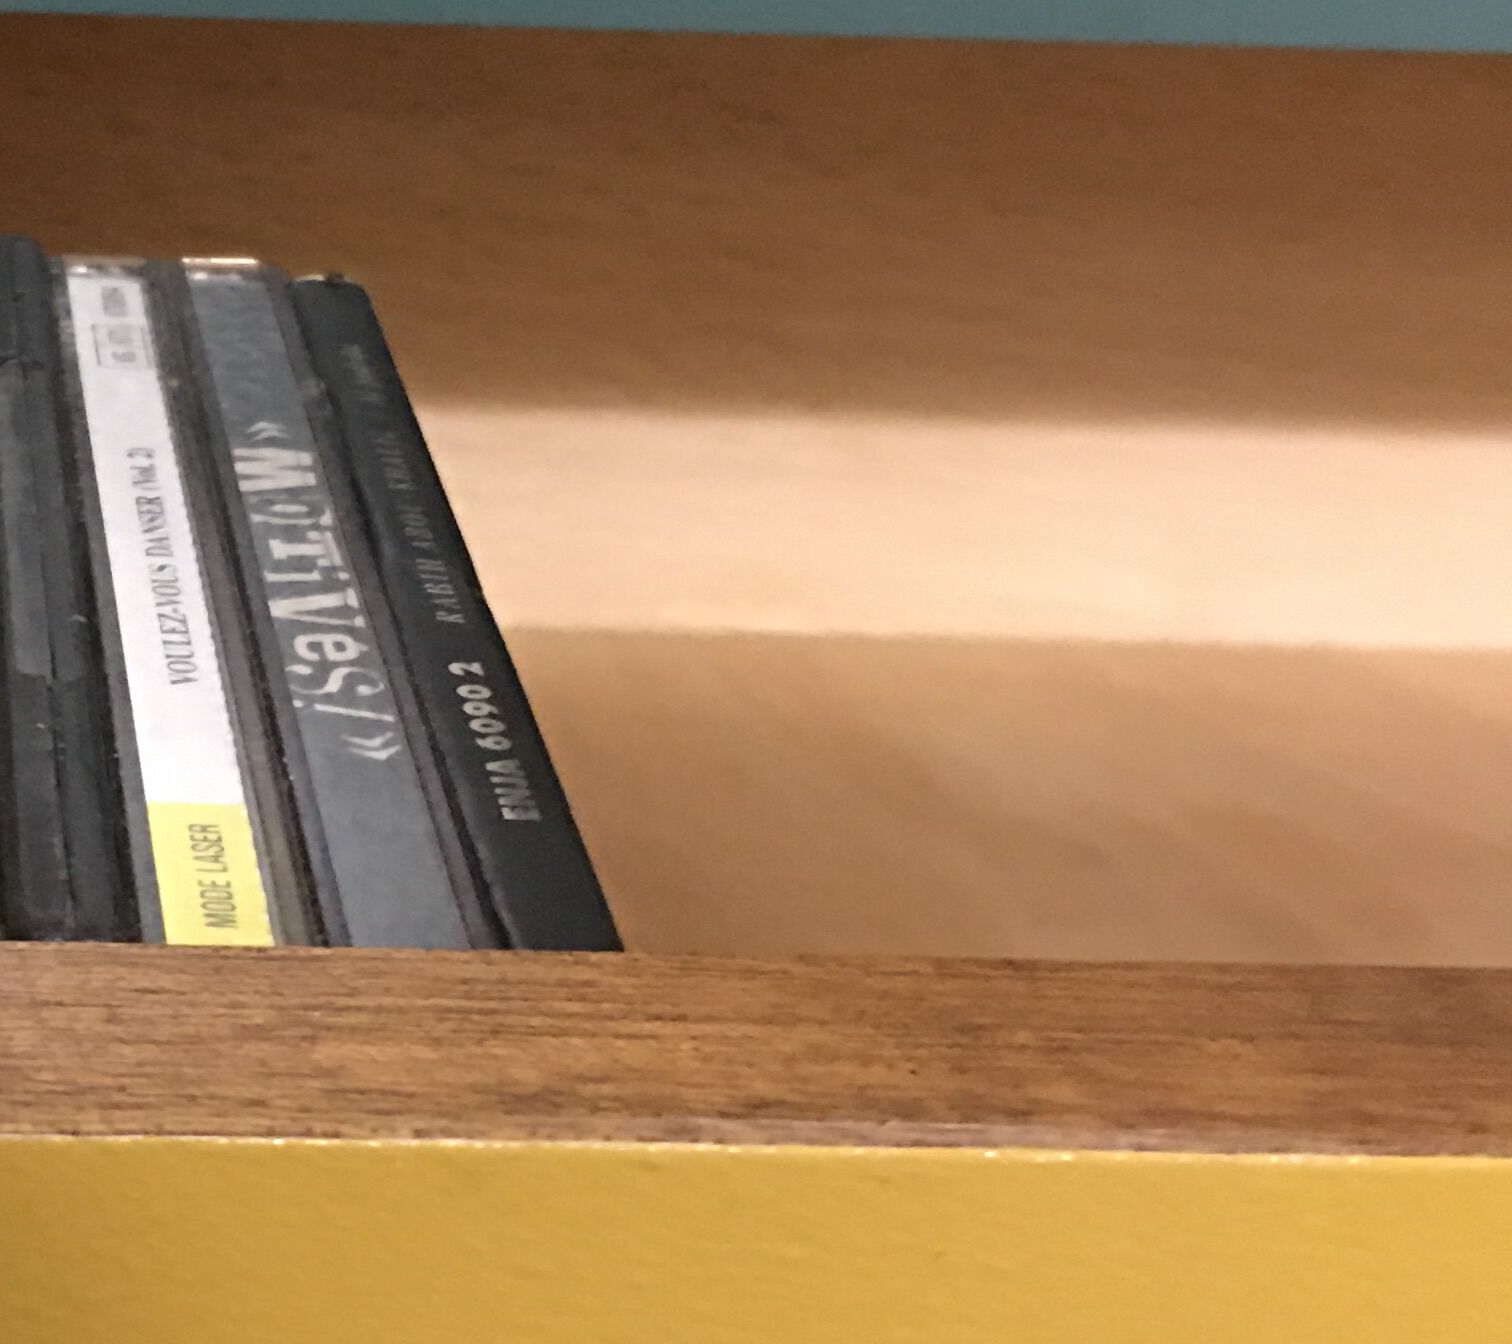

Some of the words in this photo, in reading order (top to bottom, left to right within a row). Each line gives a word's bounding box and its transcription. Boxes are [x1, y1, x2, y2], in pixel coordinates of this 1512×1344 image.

[136, 496, 174, 558] DANSER
[147, 564, 198, 685] VOULEZ-VOUS
[446, 660, 488, 677] 2
[456, 683, 513, 751] 6090
[484, 758, 543, 821] ENJA
[187, 823, 230, 875] LASER
[198, 879, 239, 930] MODE
